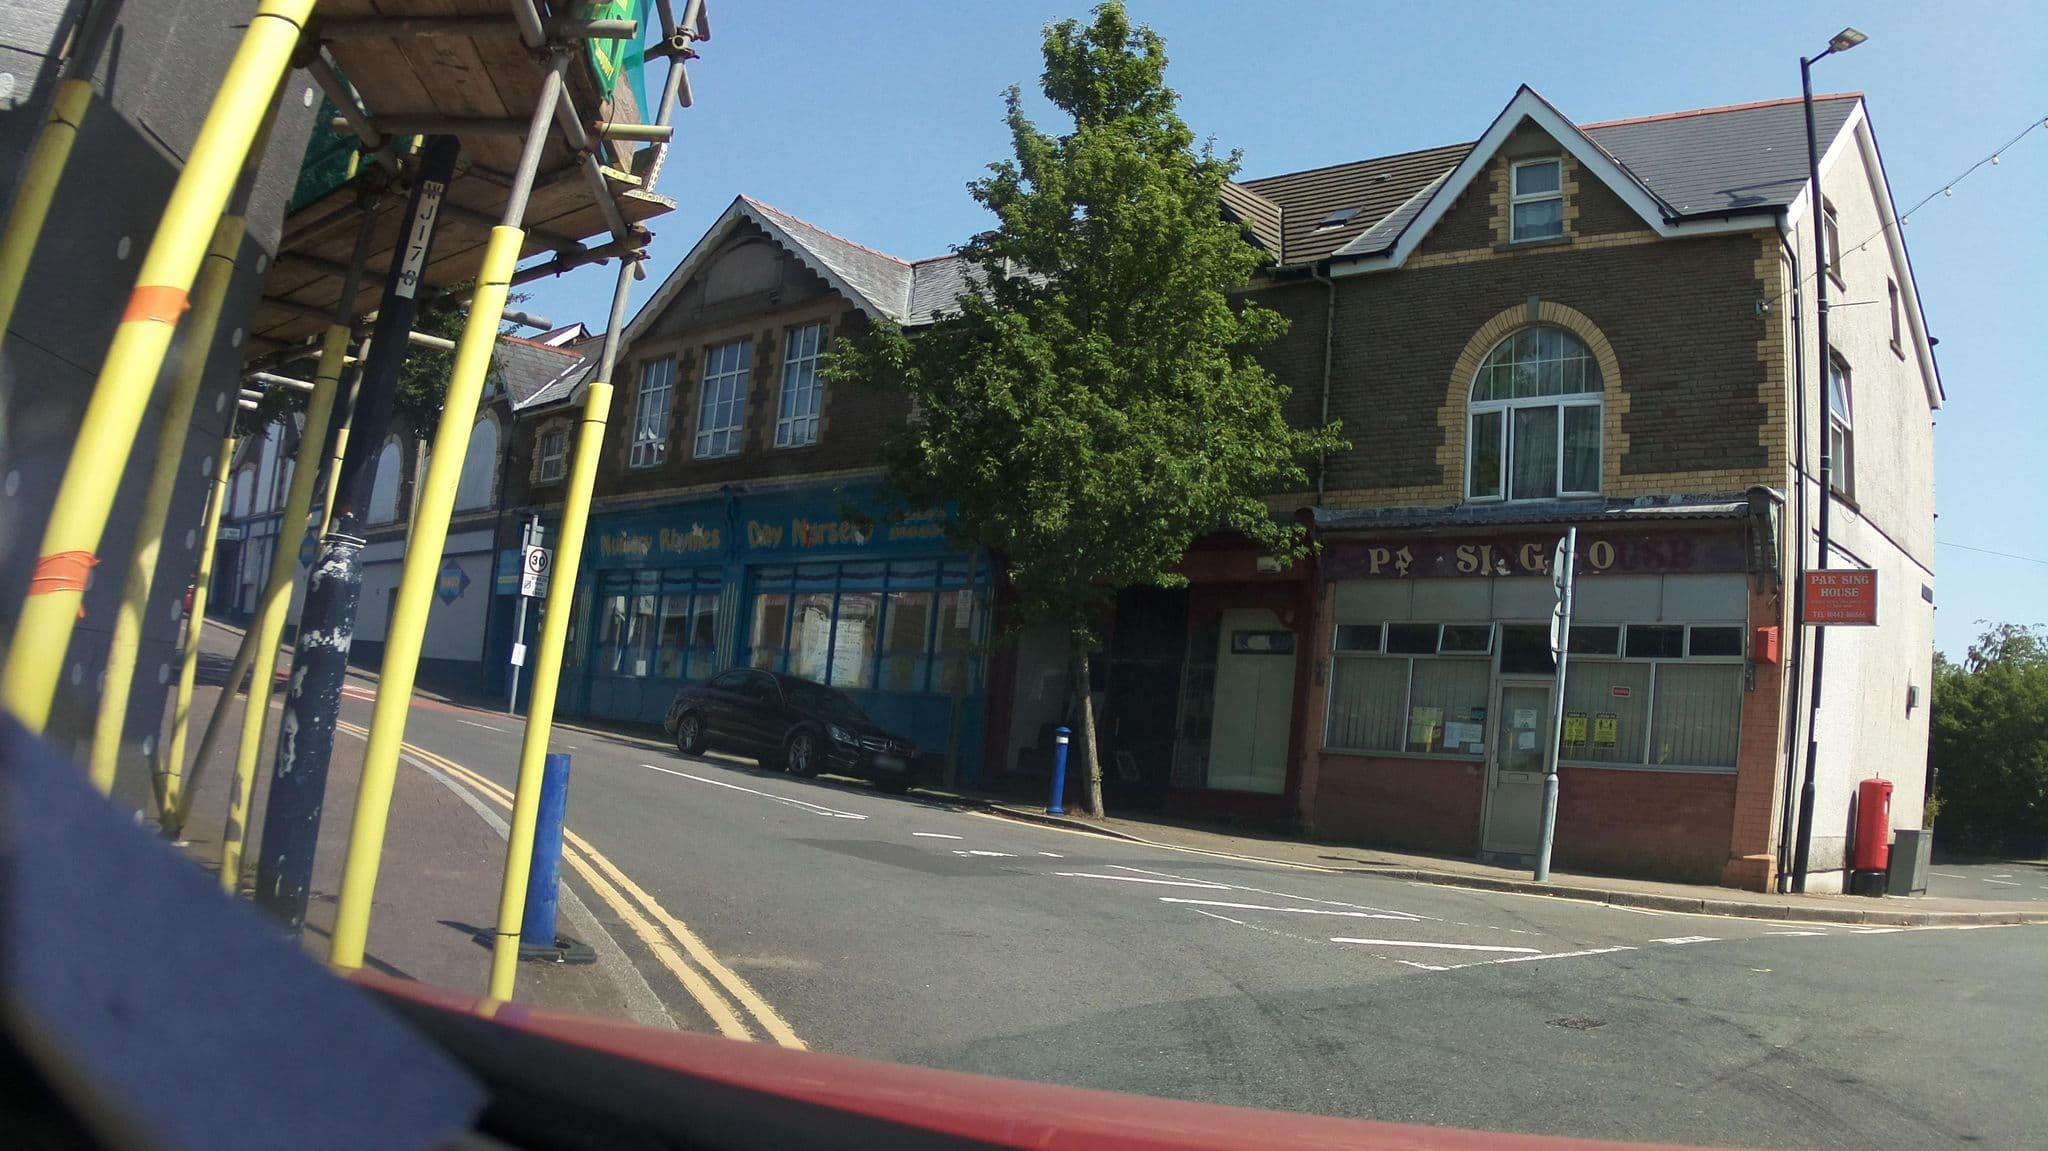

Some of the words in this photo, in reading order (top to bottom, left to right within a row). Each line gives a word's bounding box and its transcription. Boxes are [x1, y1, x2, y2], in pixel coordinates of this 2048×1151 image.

[747, 519, 783, 547] Day
[531, 555, 546, 566] 30
[1811, 575, 1837, 585] PAK
[1842, 575, 1870, 585] SING
[1820, 587, 1860, 597] HOUSE
